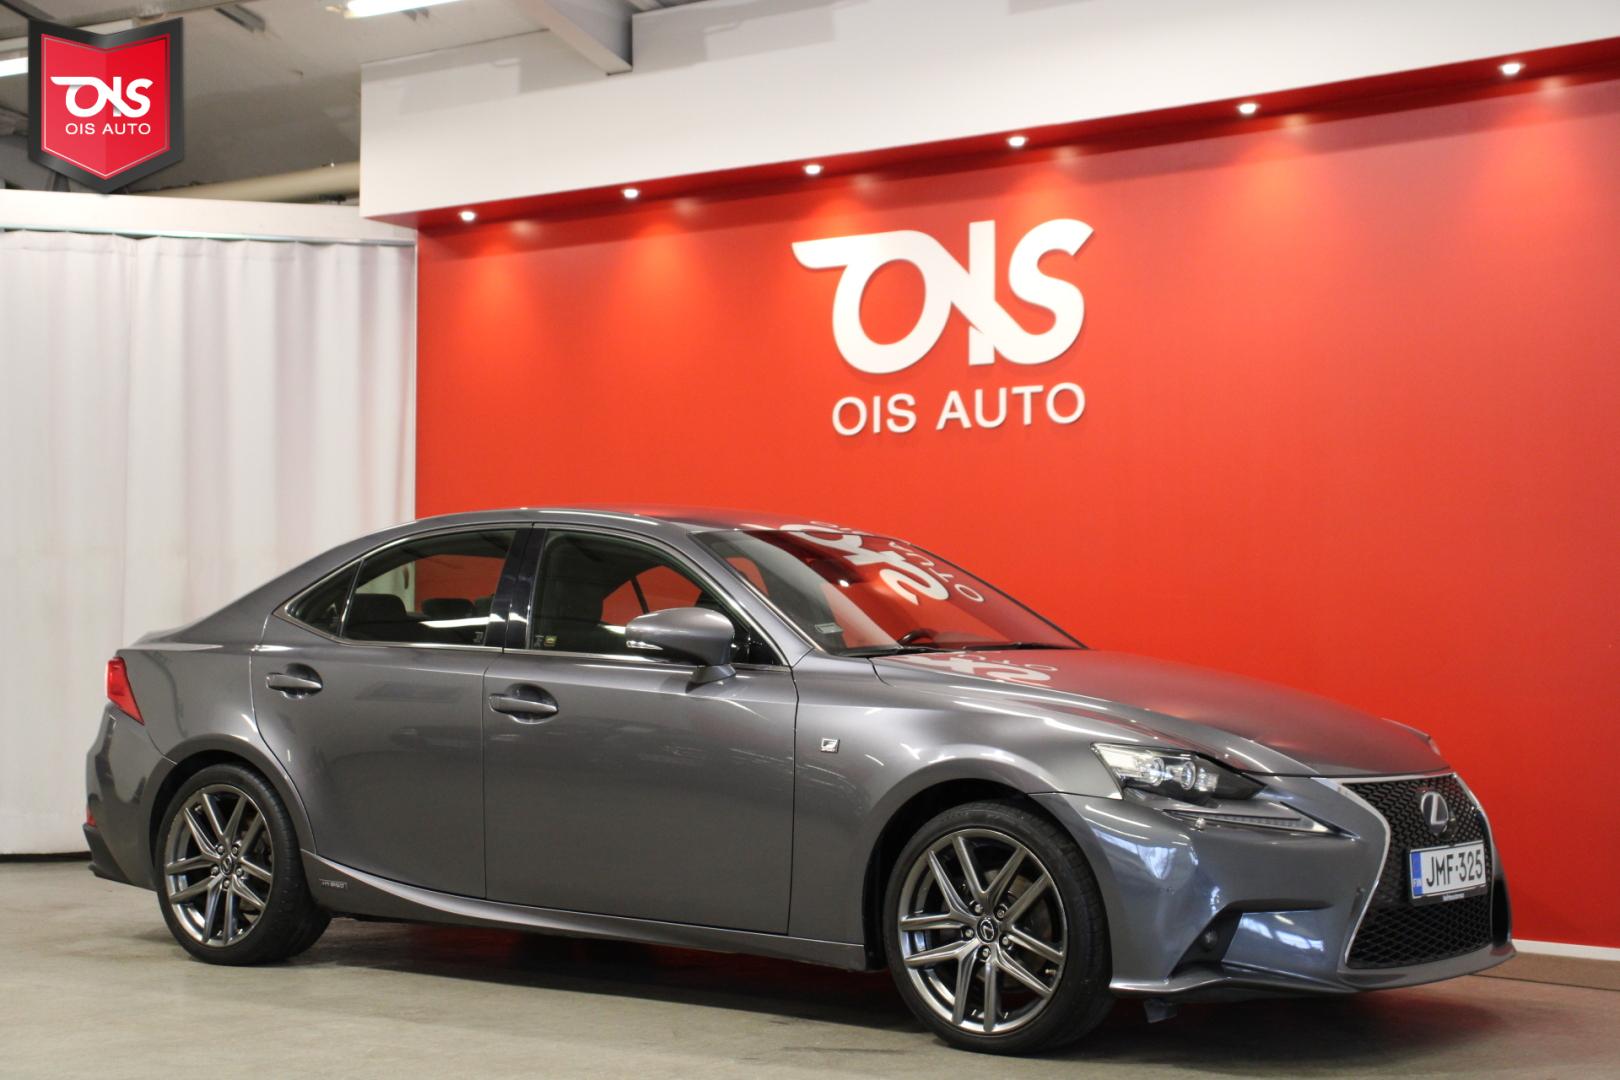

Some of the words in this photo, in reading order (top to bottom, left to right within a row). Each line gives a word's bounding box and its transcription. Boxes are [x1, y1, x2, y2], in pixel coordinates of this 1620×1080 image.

[832, 393, 917, 436] OIS
[936, 382, 1086, 430] AUTO
[1426, 849, 1483, 888] JMF-325
